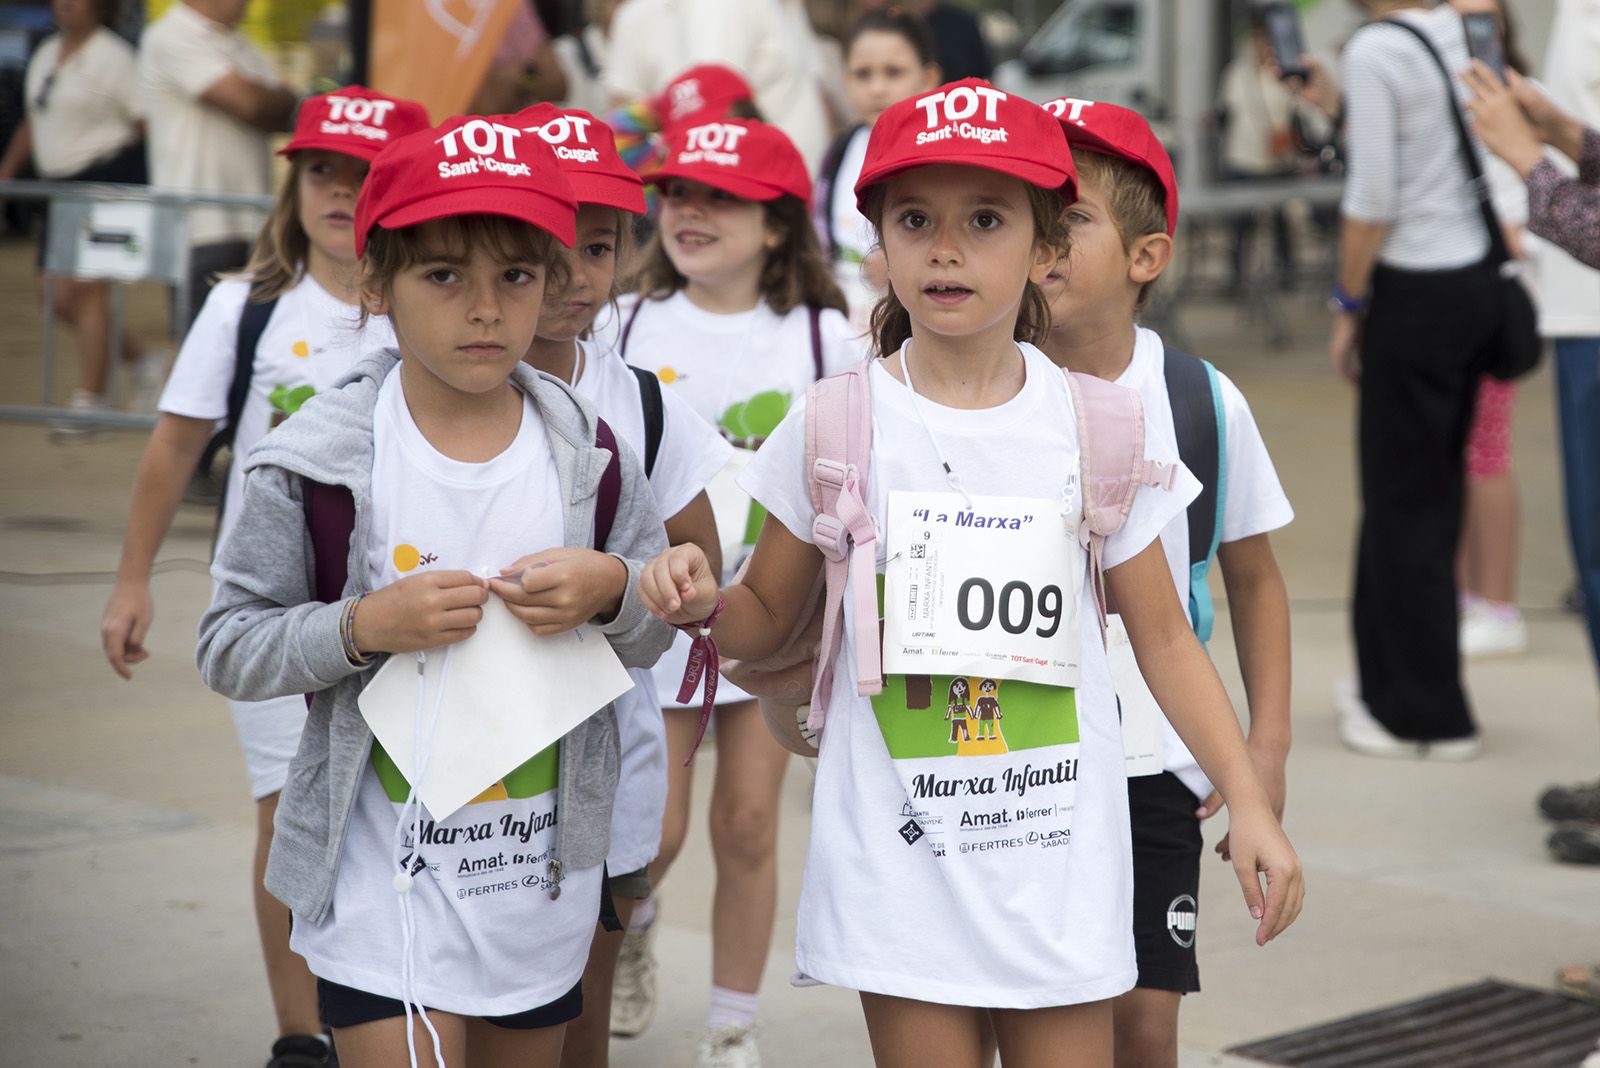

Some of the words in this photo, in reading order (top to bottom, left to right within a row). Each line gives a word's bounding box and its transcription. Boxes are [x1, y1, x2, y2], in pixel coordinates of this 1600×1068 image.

[325, 95, 395, 126] TOT
[916, 86, 1007, 128] TOT
[1039, 97, 1094, 120] OT
[434, 119, 521, 160] TOT
[685, 122, 747, 151] TOT
[916, 126, 952, 144] Sant
[959, 122, 1008, 144] Cugat
[558, 146, 600, 163] Cugat
[437, 158, 480, 178] Sant
[485, 157, 532, 177] Cugat
[923, 531, 931, 541] 9
[957, 576, 1063, 638] 009
[902, 647, 925, 655] Amat.
[686, 647, 704, 683] DRUNI
[912, 773, 997, 799] Marxa
[1002, 758, 1079, 797] Infantil
[959, 809, 1012, 827] Amat.
[1025, 807, 1052, 820] ferrer
[411, 819, 494, 844] Marxa
[971, 839, 1024, 852] FERTRES
[457, 852, 508, 874] Amat.
[467, 880, 519, 897] FERTRES
